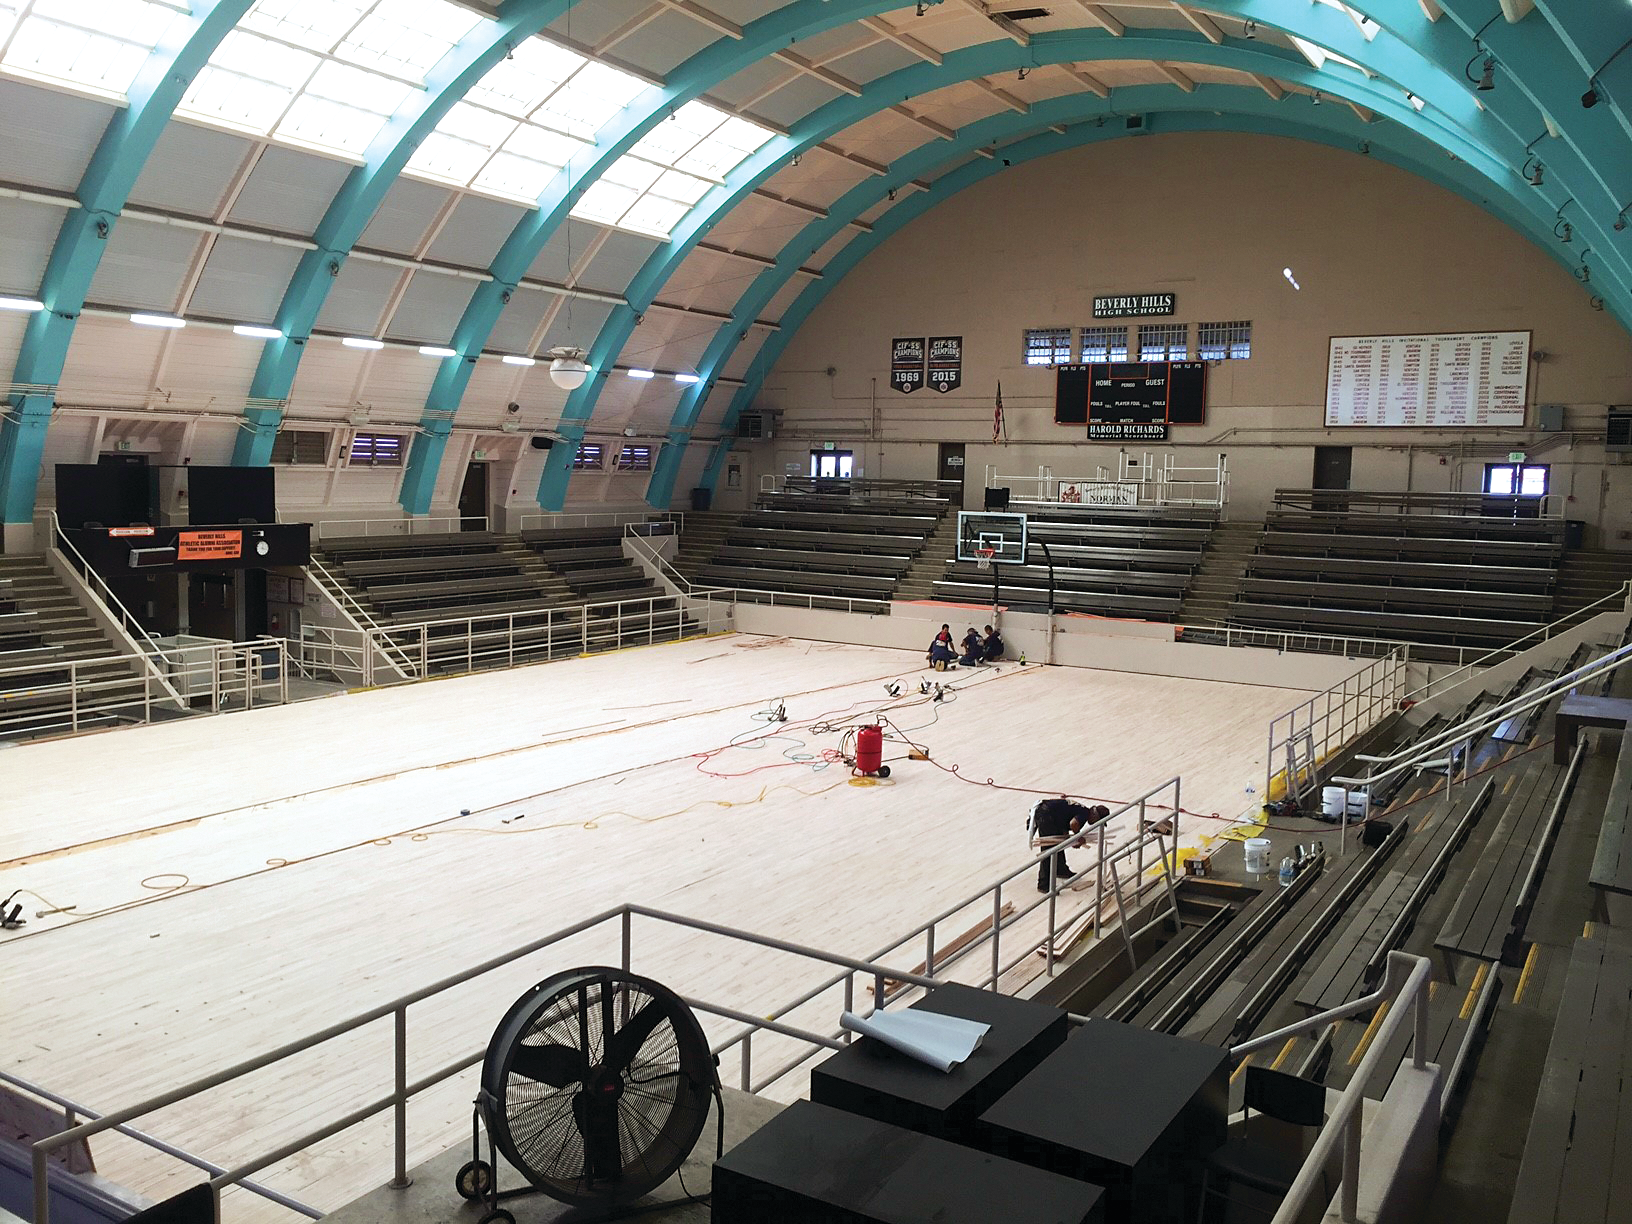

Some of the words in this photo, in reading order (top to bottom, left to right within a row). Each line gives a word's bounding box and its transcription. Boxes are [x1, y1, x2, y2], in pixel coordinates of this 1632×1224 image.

[1095, 297, 1140, 309] BEVERLY
[1141, 295, 1171, 307] HILLS
[894, 348, 922, 359] CHAMPIONS
[930, 348, 959, 358] CHAMPIONS
[895, 372, 919, 382] 1969
[932, 372, 956, 381] 2015
[1090, 426, 1122, 434] HAROLD
[1124, 425, 1164, 434] RICHARDS
